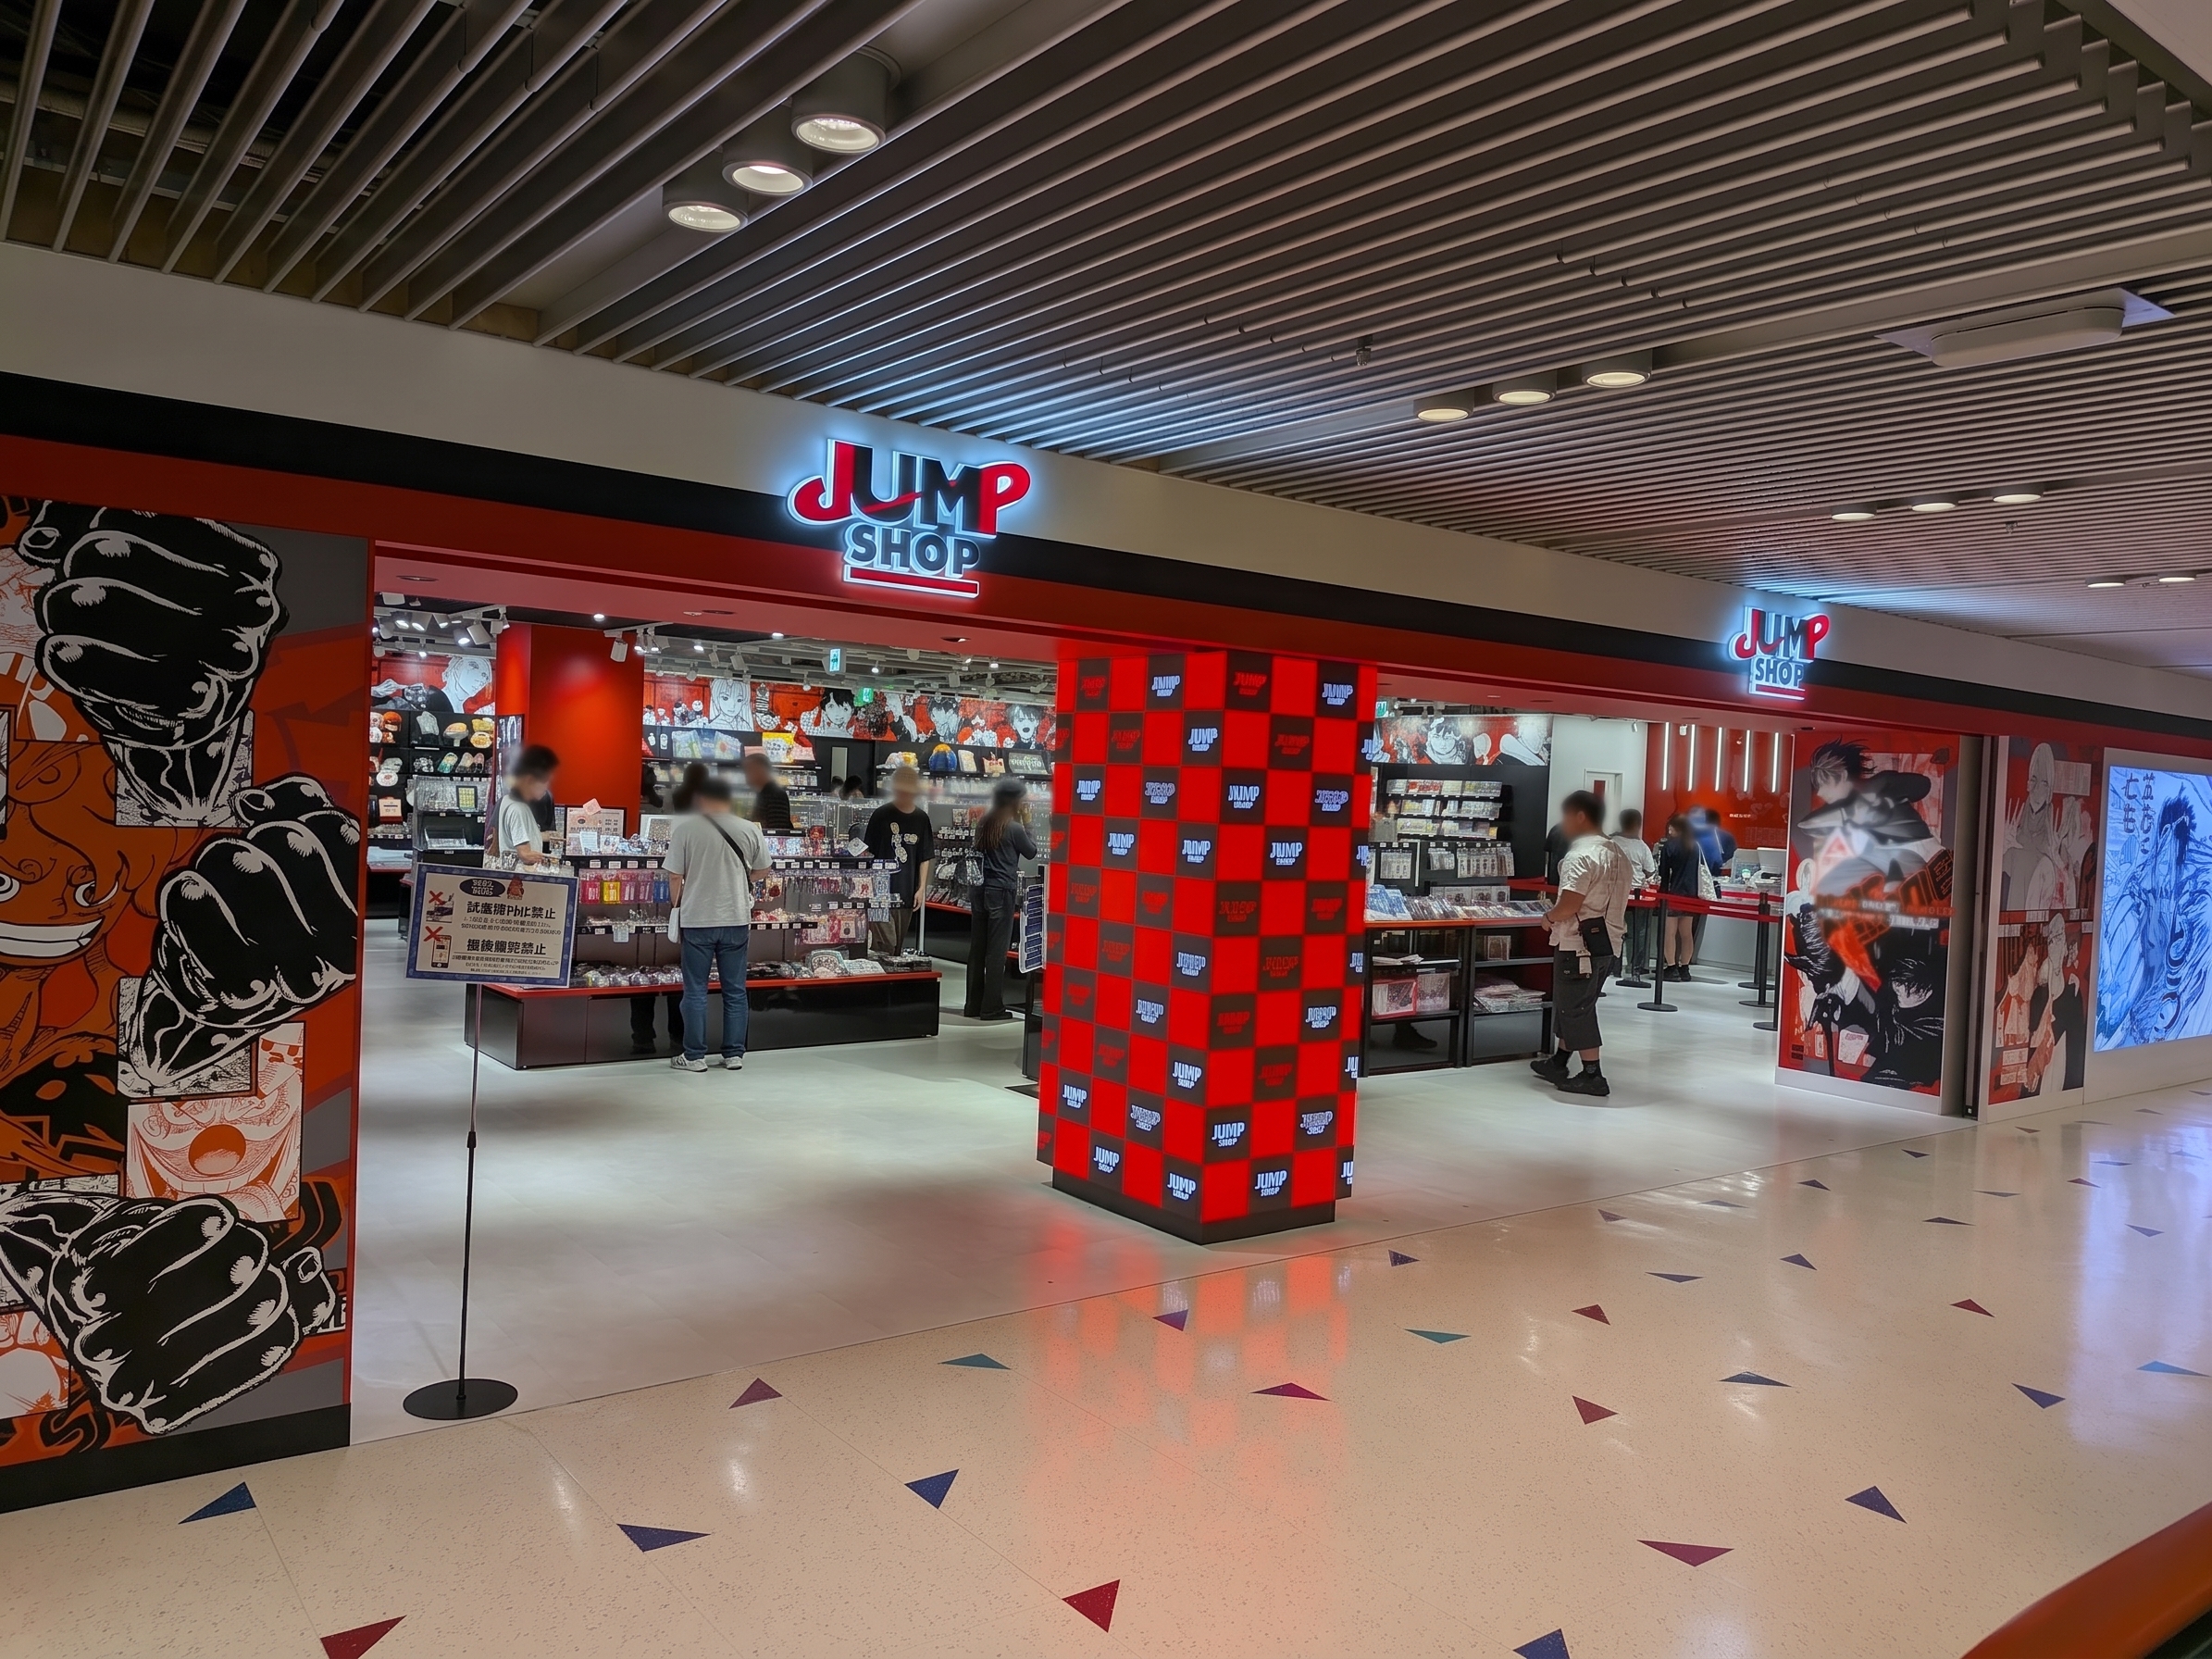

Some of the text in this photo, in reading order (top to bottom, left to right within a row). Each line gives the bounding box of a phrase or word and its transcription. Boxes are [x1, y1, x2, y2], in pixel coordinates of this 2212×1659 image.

[789, 440, 1030, 537] JUMP
[846, 524, 979, 577] SHOP
[1731, 607, 1829, 661] JUMP
[1754, 657, 1804, 687] SHOP
[1173, 1062, 1201, 1082] JUMP
[1063, 1085, 1087, 1104] JUMP
[1212, 1122, 1245, 1141] JUMP
[1094, 1146, 1119, 1167] JUMP
[1167, 1172, 1196, 1194] JUMP
[1255, 1170, 1287, 1190] JUMP
